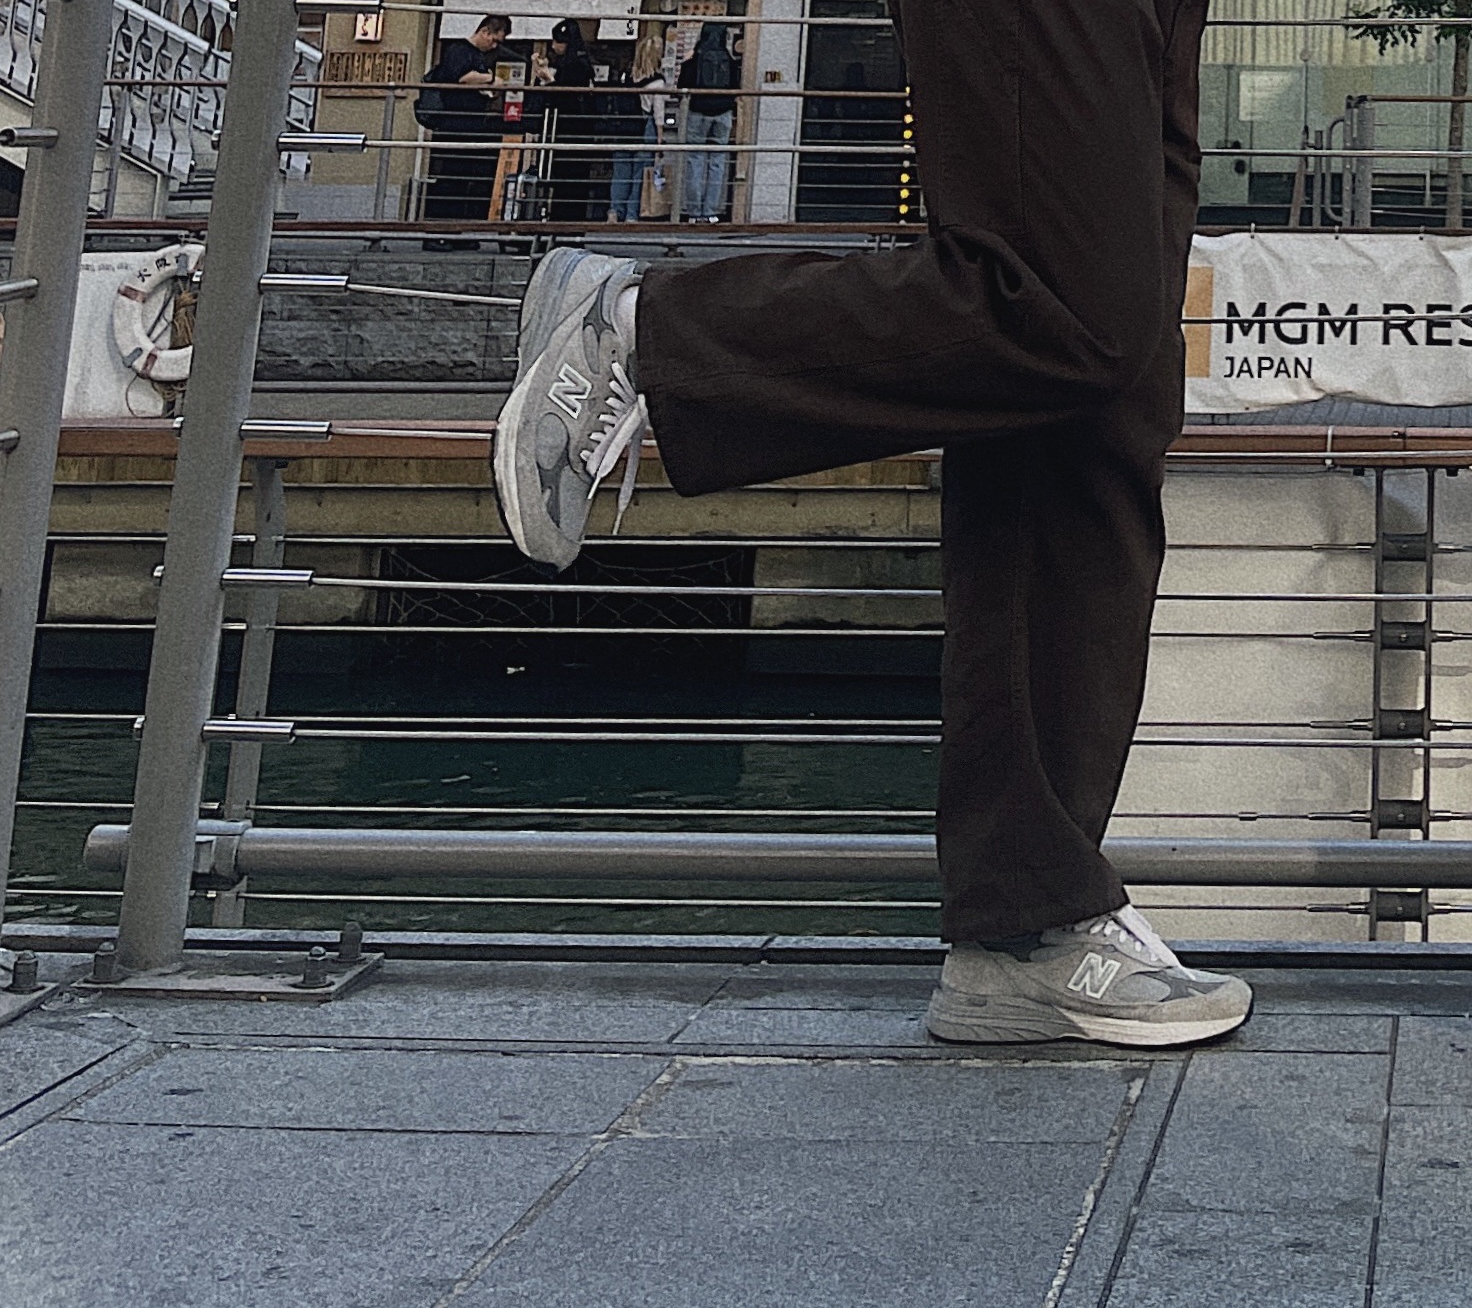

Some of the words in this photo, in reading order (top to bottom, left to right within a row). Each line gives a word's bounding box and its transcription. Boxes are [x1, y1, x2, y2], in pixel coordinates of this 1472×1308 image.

[1225, 301, 1358, 346] MGM
[1223, 356, 1312, 379] JAPAN
[1066, 951, 1123, 999] N
